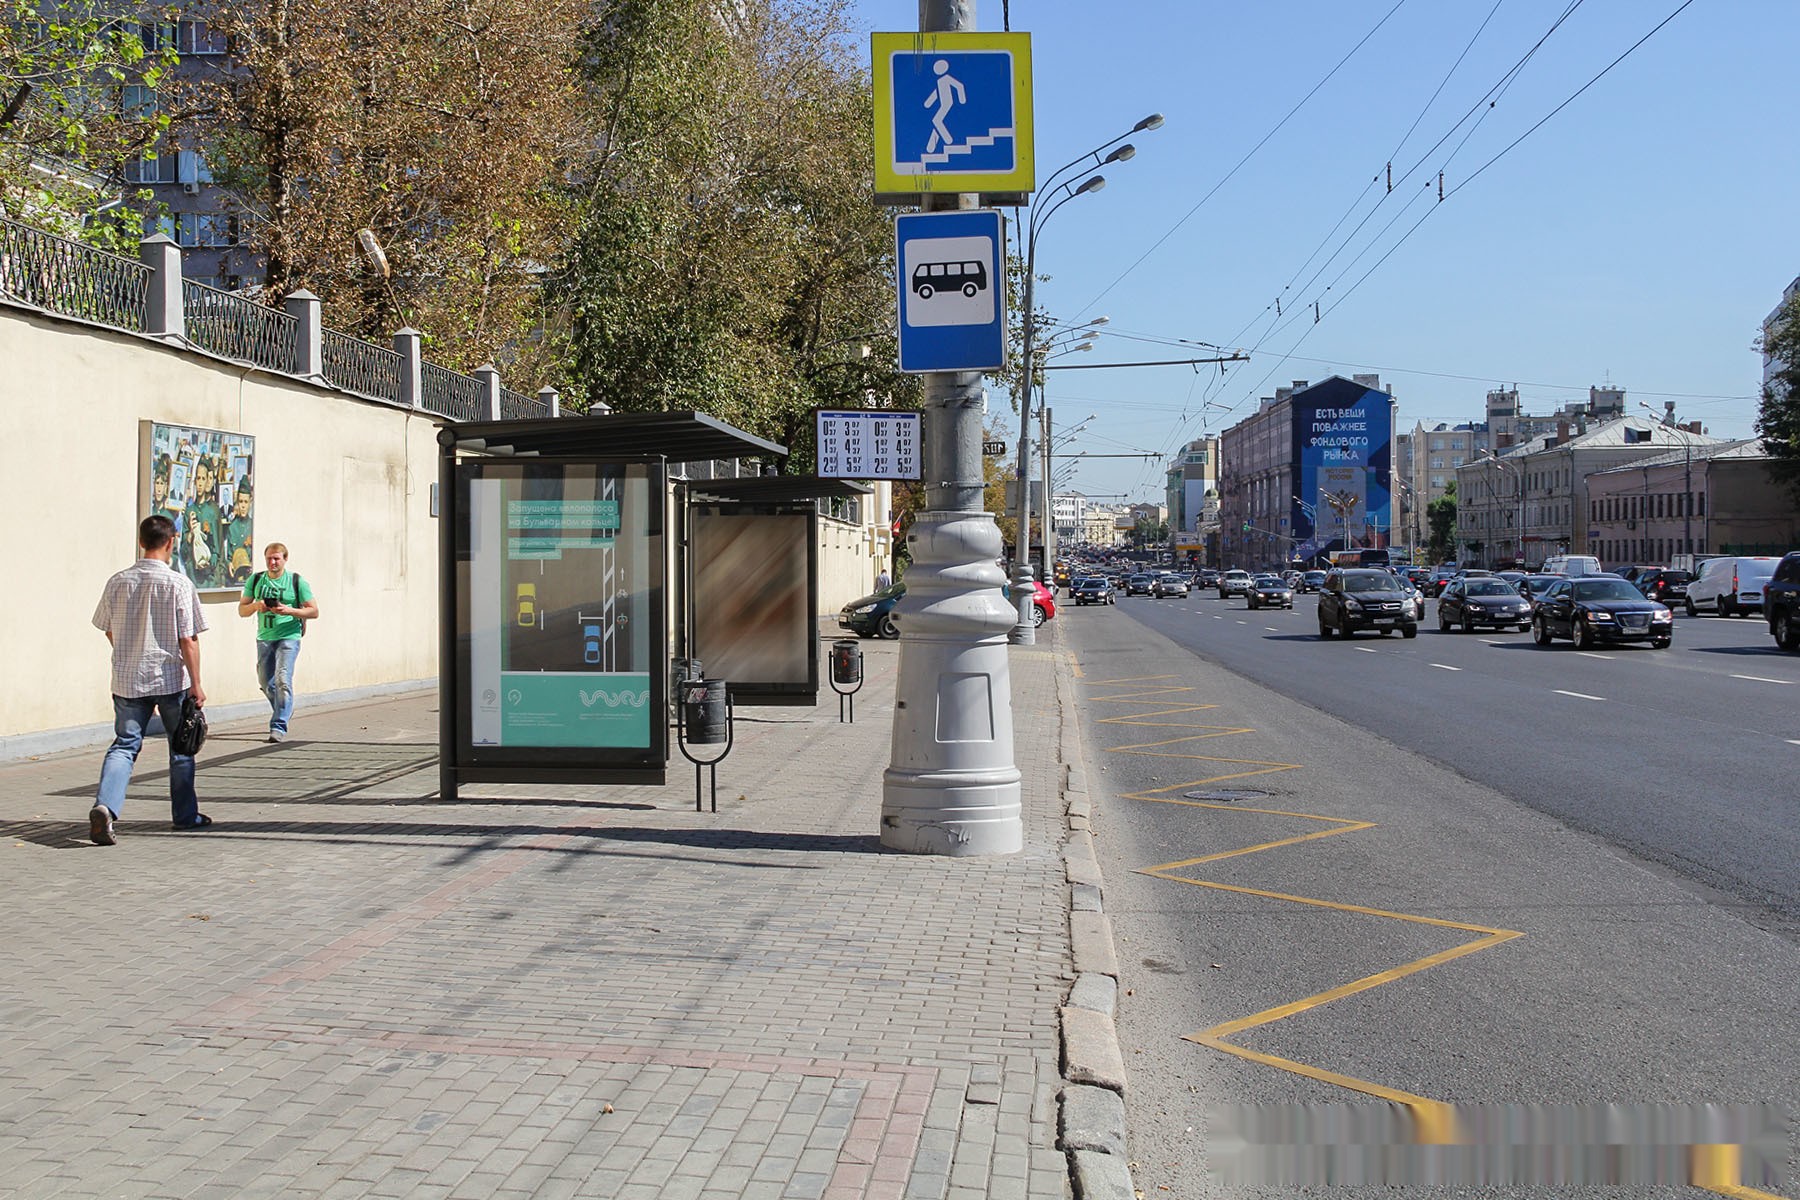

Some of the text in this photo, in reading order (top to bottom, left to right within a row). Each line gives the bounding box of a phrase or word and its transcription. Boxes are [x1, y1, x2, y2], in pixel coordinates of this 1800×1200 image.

[1316, 409, 1337, 419] ЕСТЬ
[824, 421, 828, 435] 0
[845, 422, 849, 436] 3
[875, 422, 879, 436] 0
[896, 422, 901, 437] 3
[1312, 423, 1366, 432] ПОВАЖНЕЕ
[824, 439, 827, 453] 1
[845, 439, 850, 454] 4
[875, 440, 879, 454] 1
[896, 440, 901, 454] 4
[1310, 437, 1368, 446] ФОНДОВОГО
[1324, 451, 1359, 460] РЫНКА
[824, 457, 828, 472] 2
[847, 457, 851, 472] 5
[875, 458, 880, 473] 2
[898, 458, 902, 473] 5
[511, 502, 556, 513] Запущена
[523, 517, 580, 529] Бульварном
[581, 517, 616, 527] кольце!
[257, 585, 286, 600] JUST
[264, 615, 275, 628] IT
